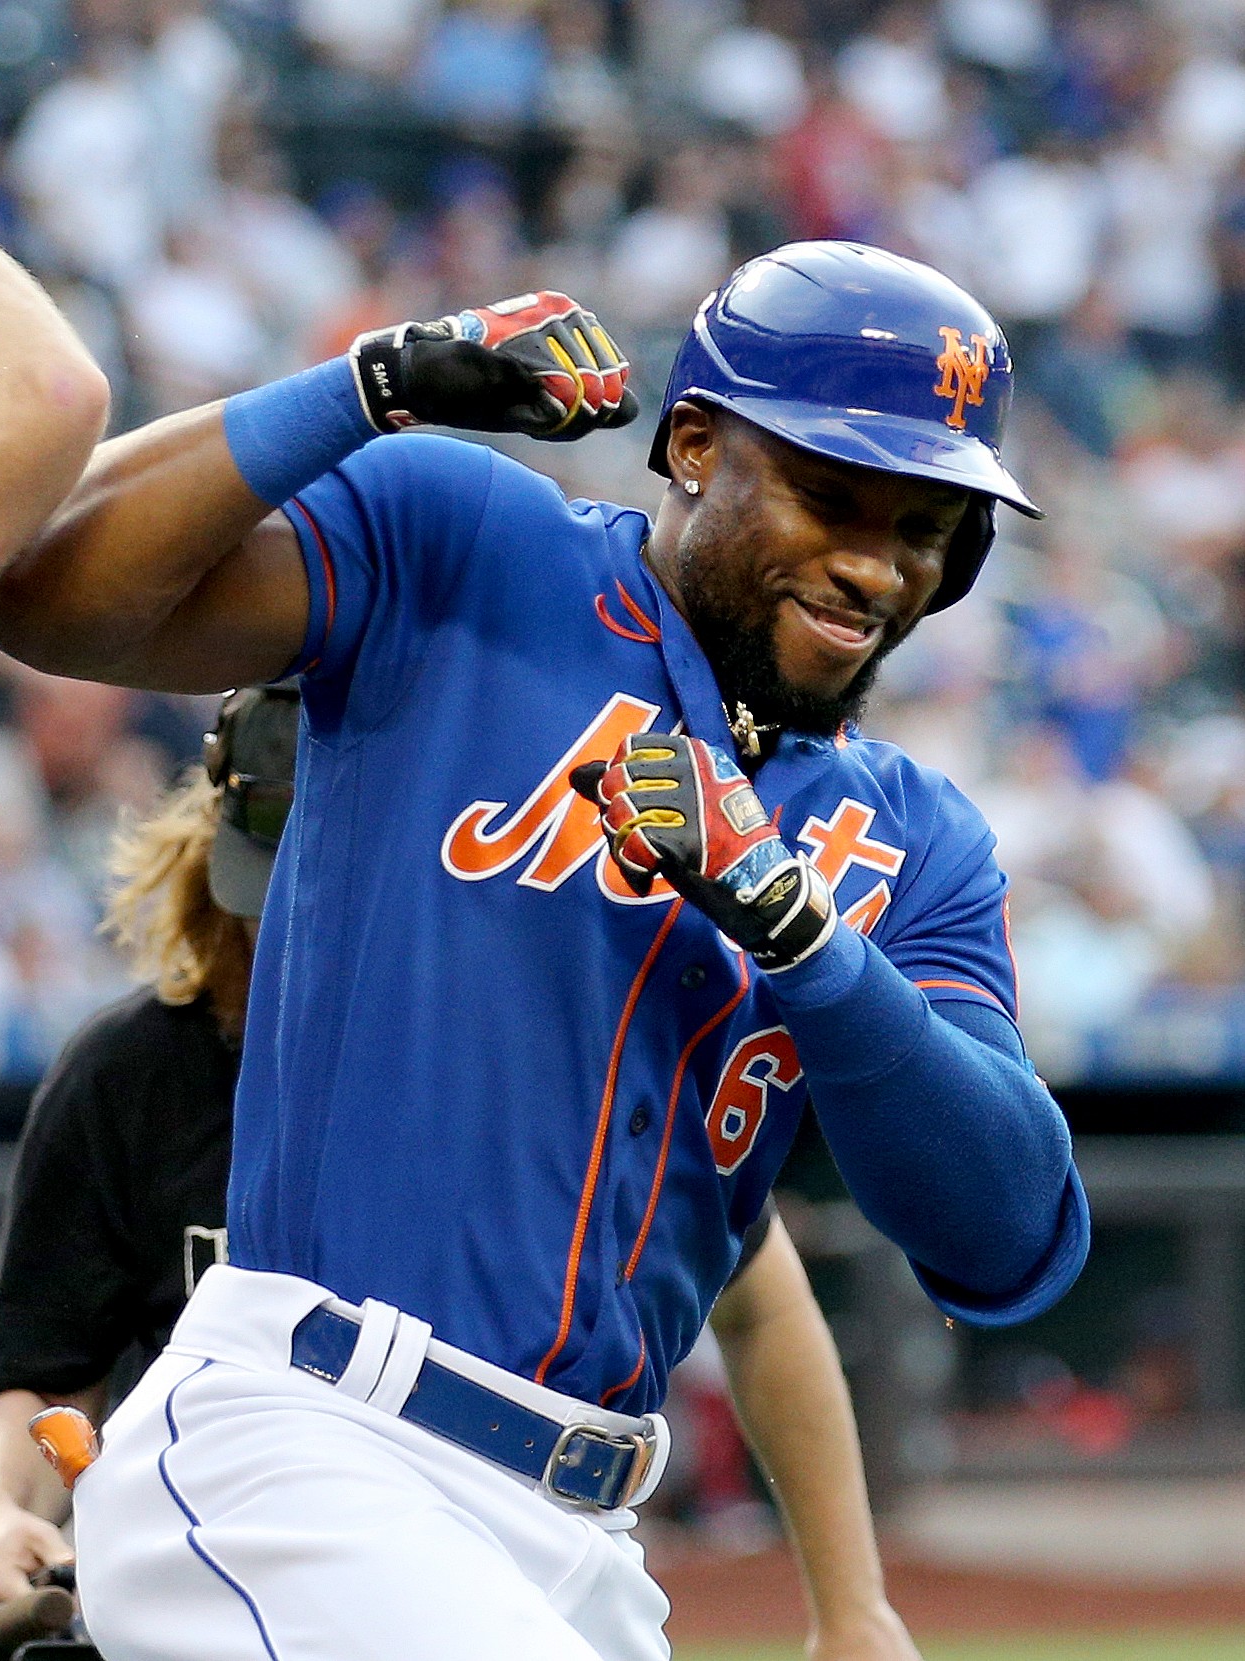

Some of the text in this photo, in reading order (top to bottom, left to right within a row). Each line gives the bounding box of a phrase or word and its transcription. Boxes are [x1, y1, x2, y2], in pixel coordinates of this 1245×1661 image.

[372, 362, 393, 397] SM-6
[934, 327, 989, 429] NY
[705, 1024, 805, 1176] 6
